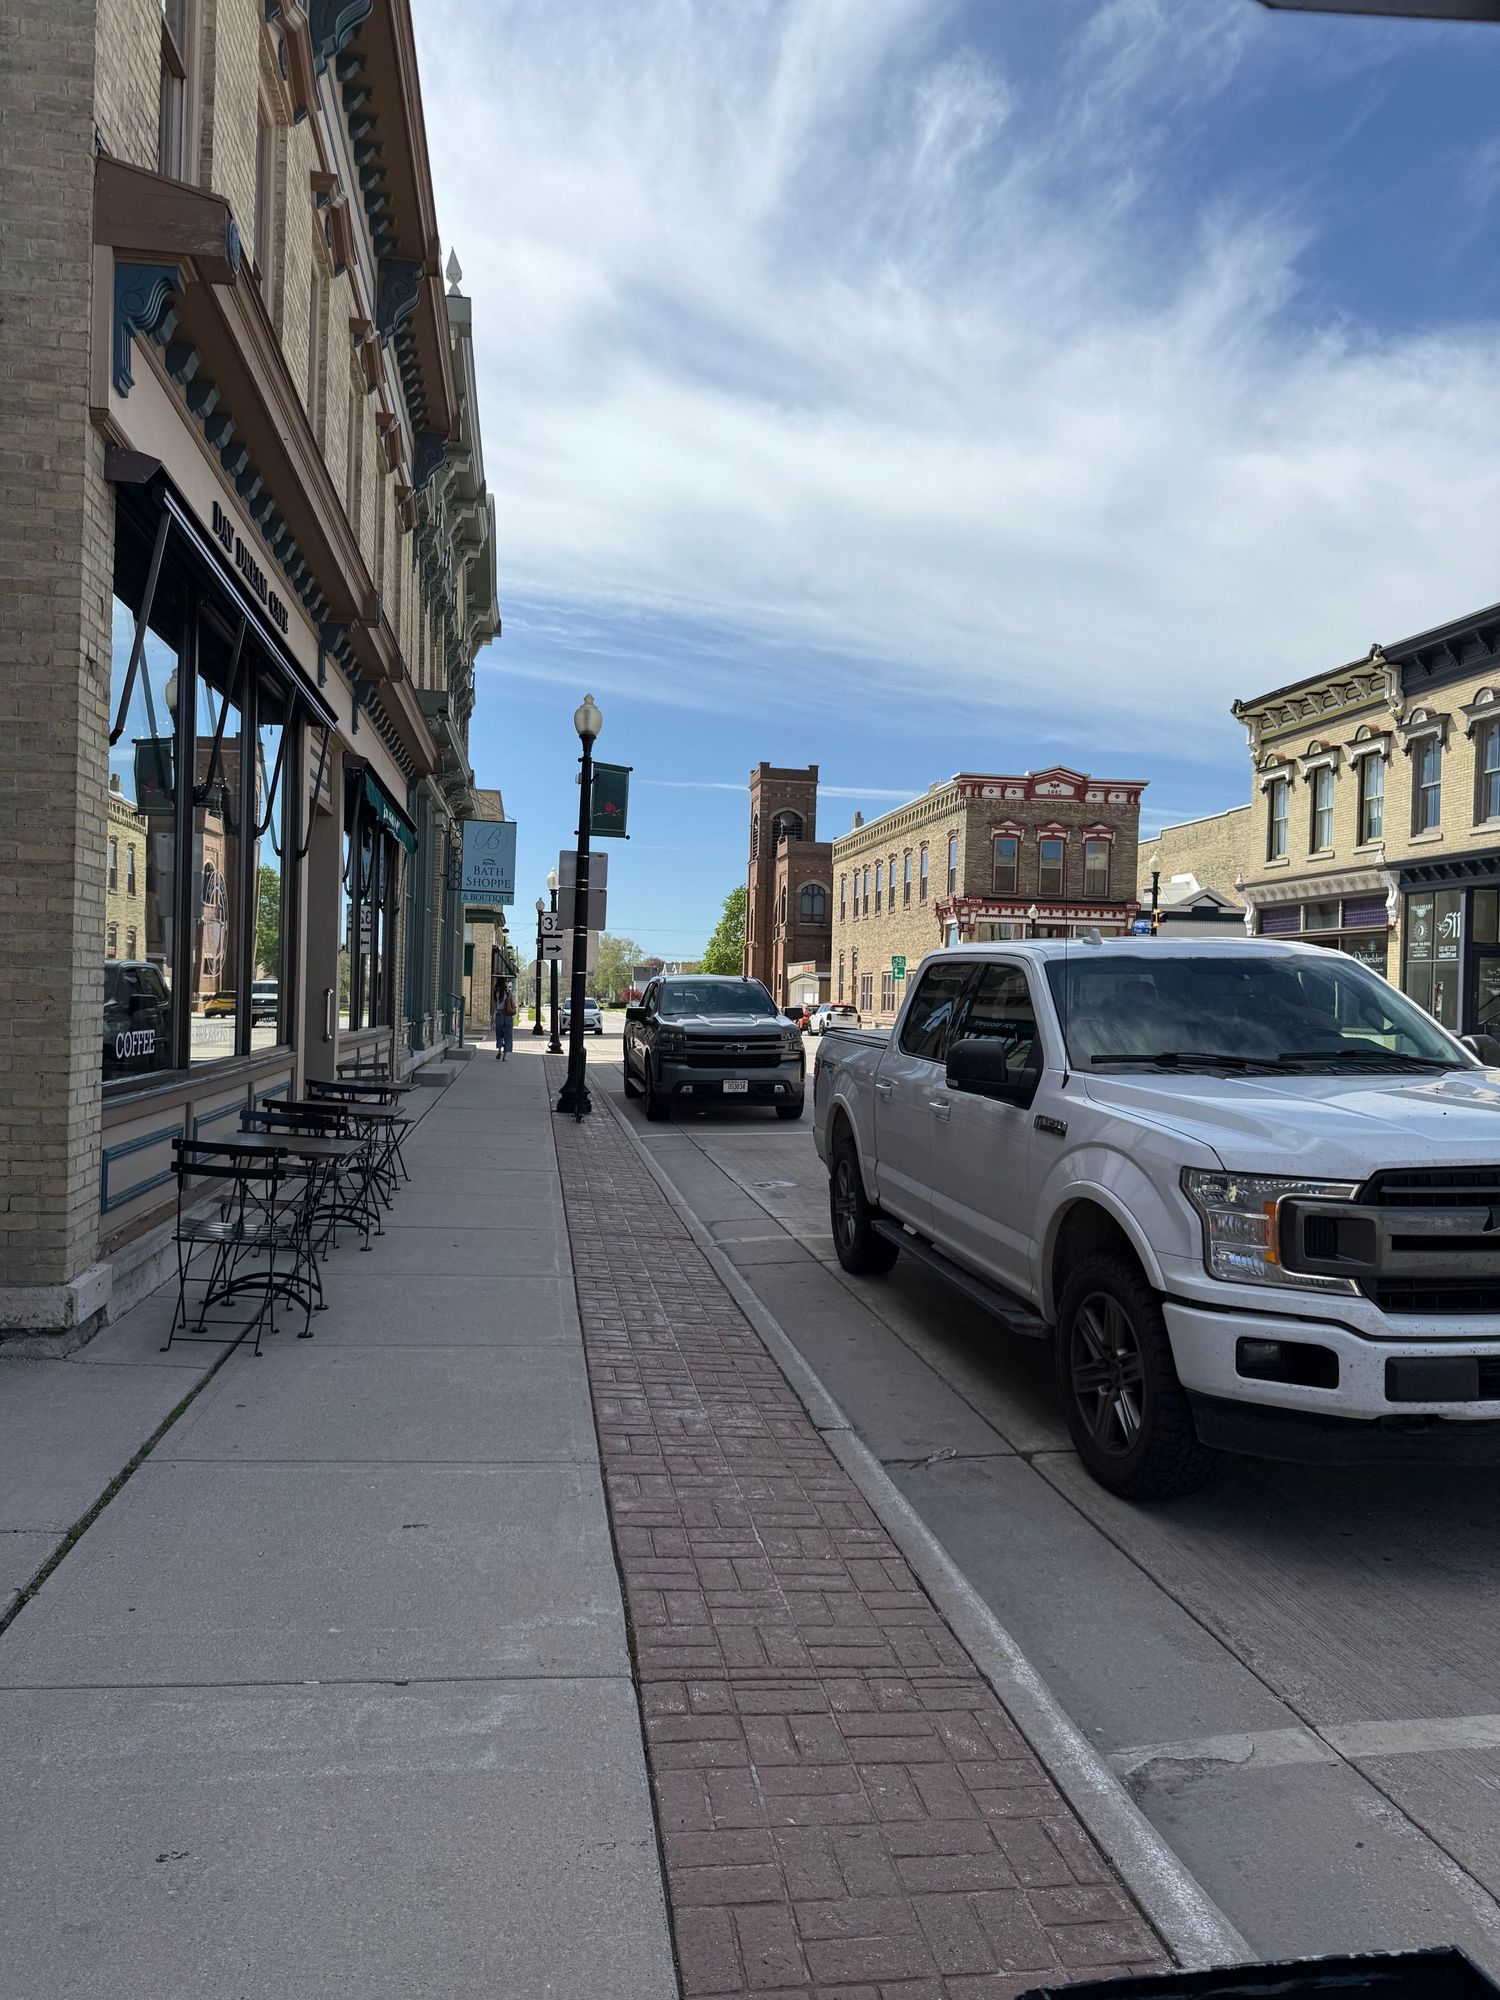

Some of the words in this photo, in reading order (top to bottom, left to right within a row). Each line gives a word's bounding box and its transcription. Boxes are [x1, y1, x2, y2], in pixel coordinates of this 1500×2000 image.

[212, 500, 235, 553] DAY
[235, 537, 269, 605] DREAM
[268, 591, 289, 634] CAFE
[473, 865, 504, 876] BATH
[466, 876, 511, 889] SHOPPE
[470, 893, 512, 903] BOUTIQUE
[1442, 911, 1461, 939] 511
[116, 1029, 156, 1059] COFFEE
